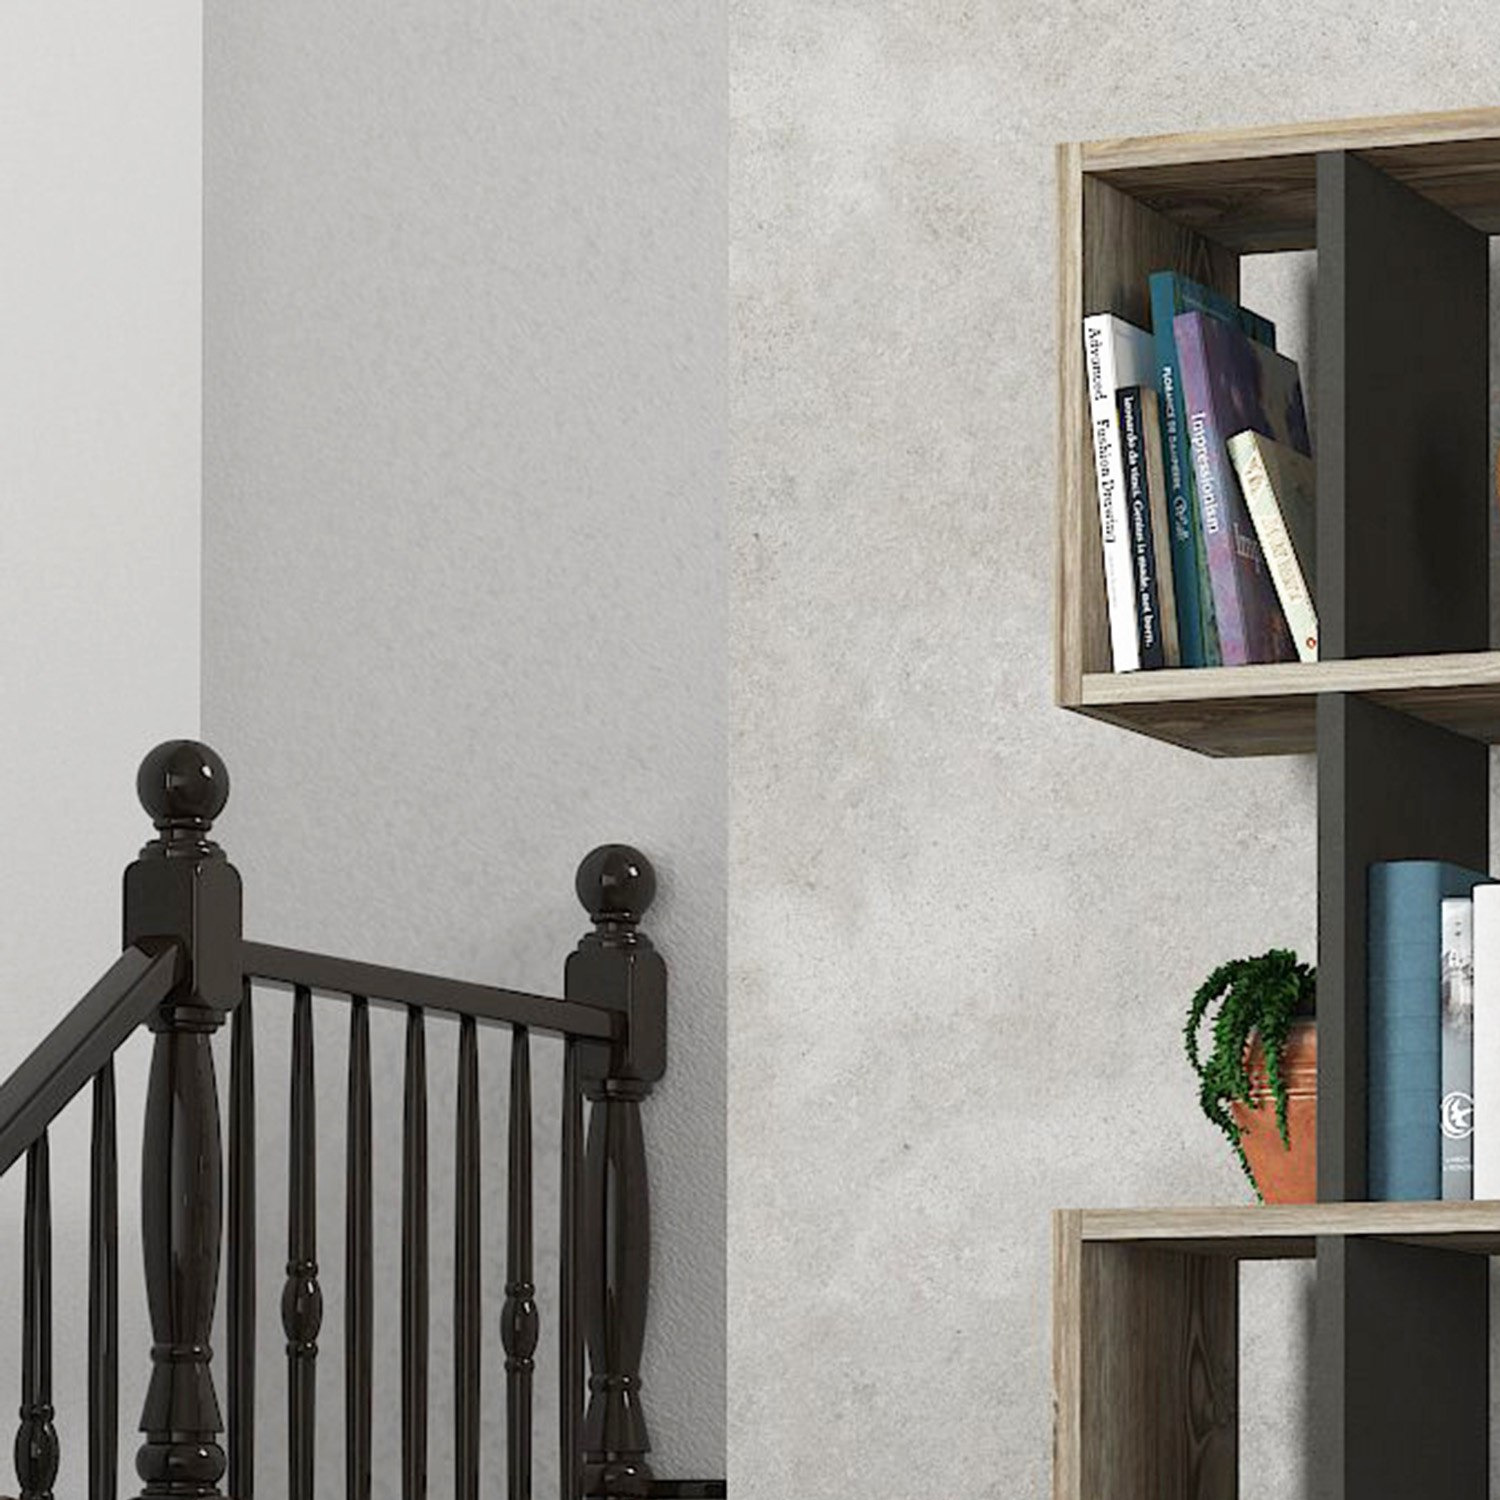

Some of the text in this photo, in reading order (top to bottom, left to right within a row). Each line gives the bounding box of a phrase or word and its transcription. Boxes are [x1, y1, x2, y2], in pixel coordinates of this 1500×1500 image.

[1088, 328, 1108, 400] Advanced
[1097, 418, 1112, 477] Fashion
[1191, 410, 1219, 534] Impressionism
[1102, 480, 1116, 542] Drawing
[1133, 500, 1145, 542] Genius
[1142, 592, 1152, 612] not
[1144, 615, 1154, 648] born.
